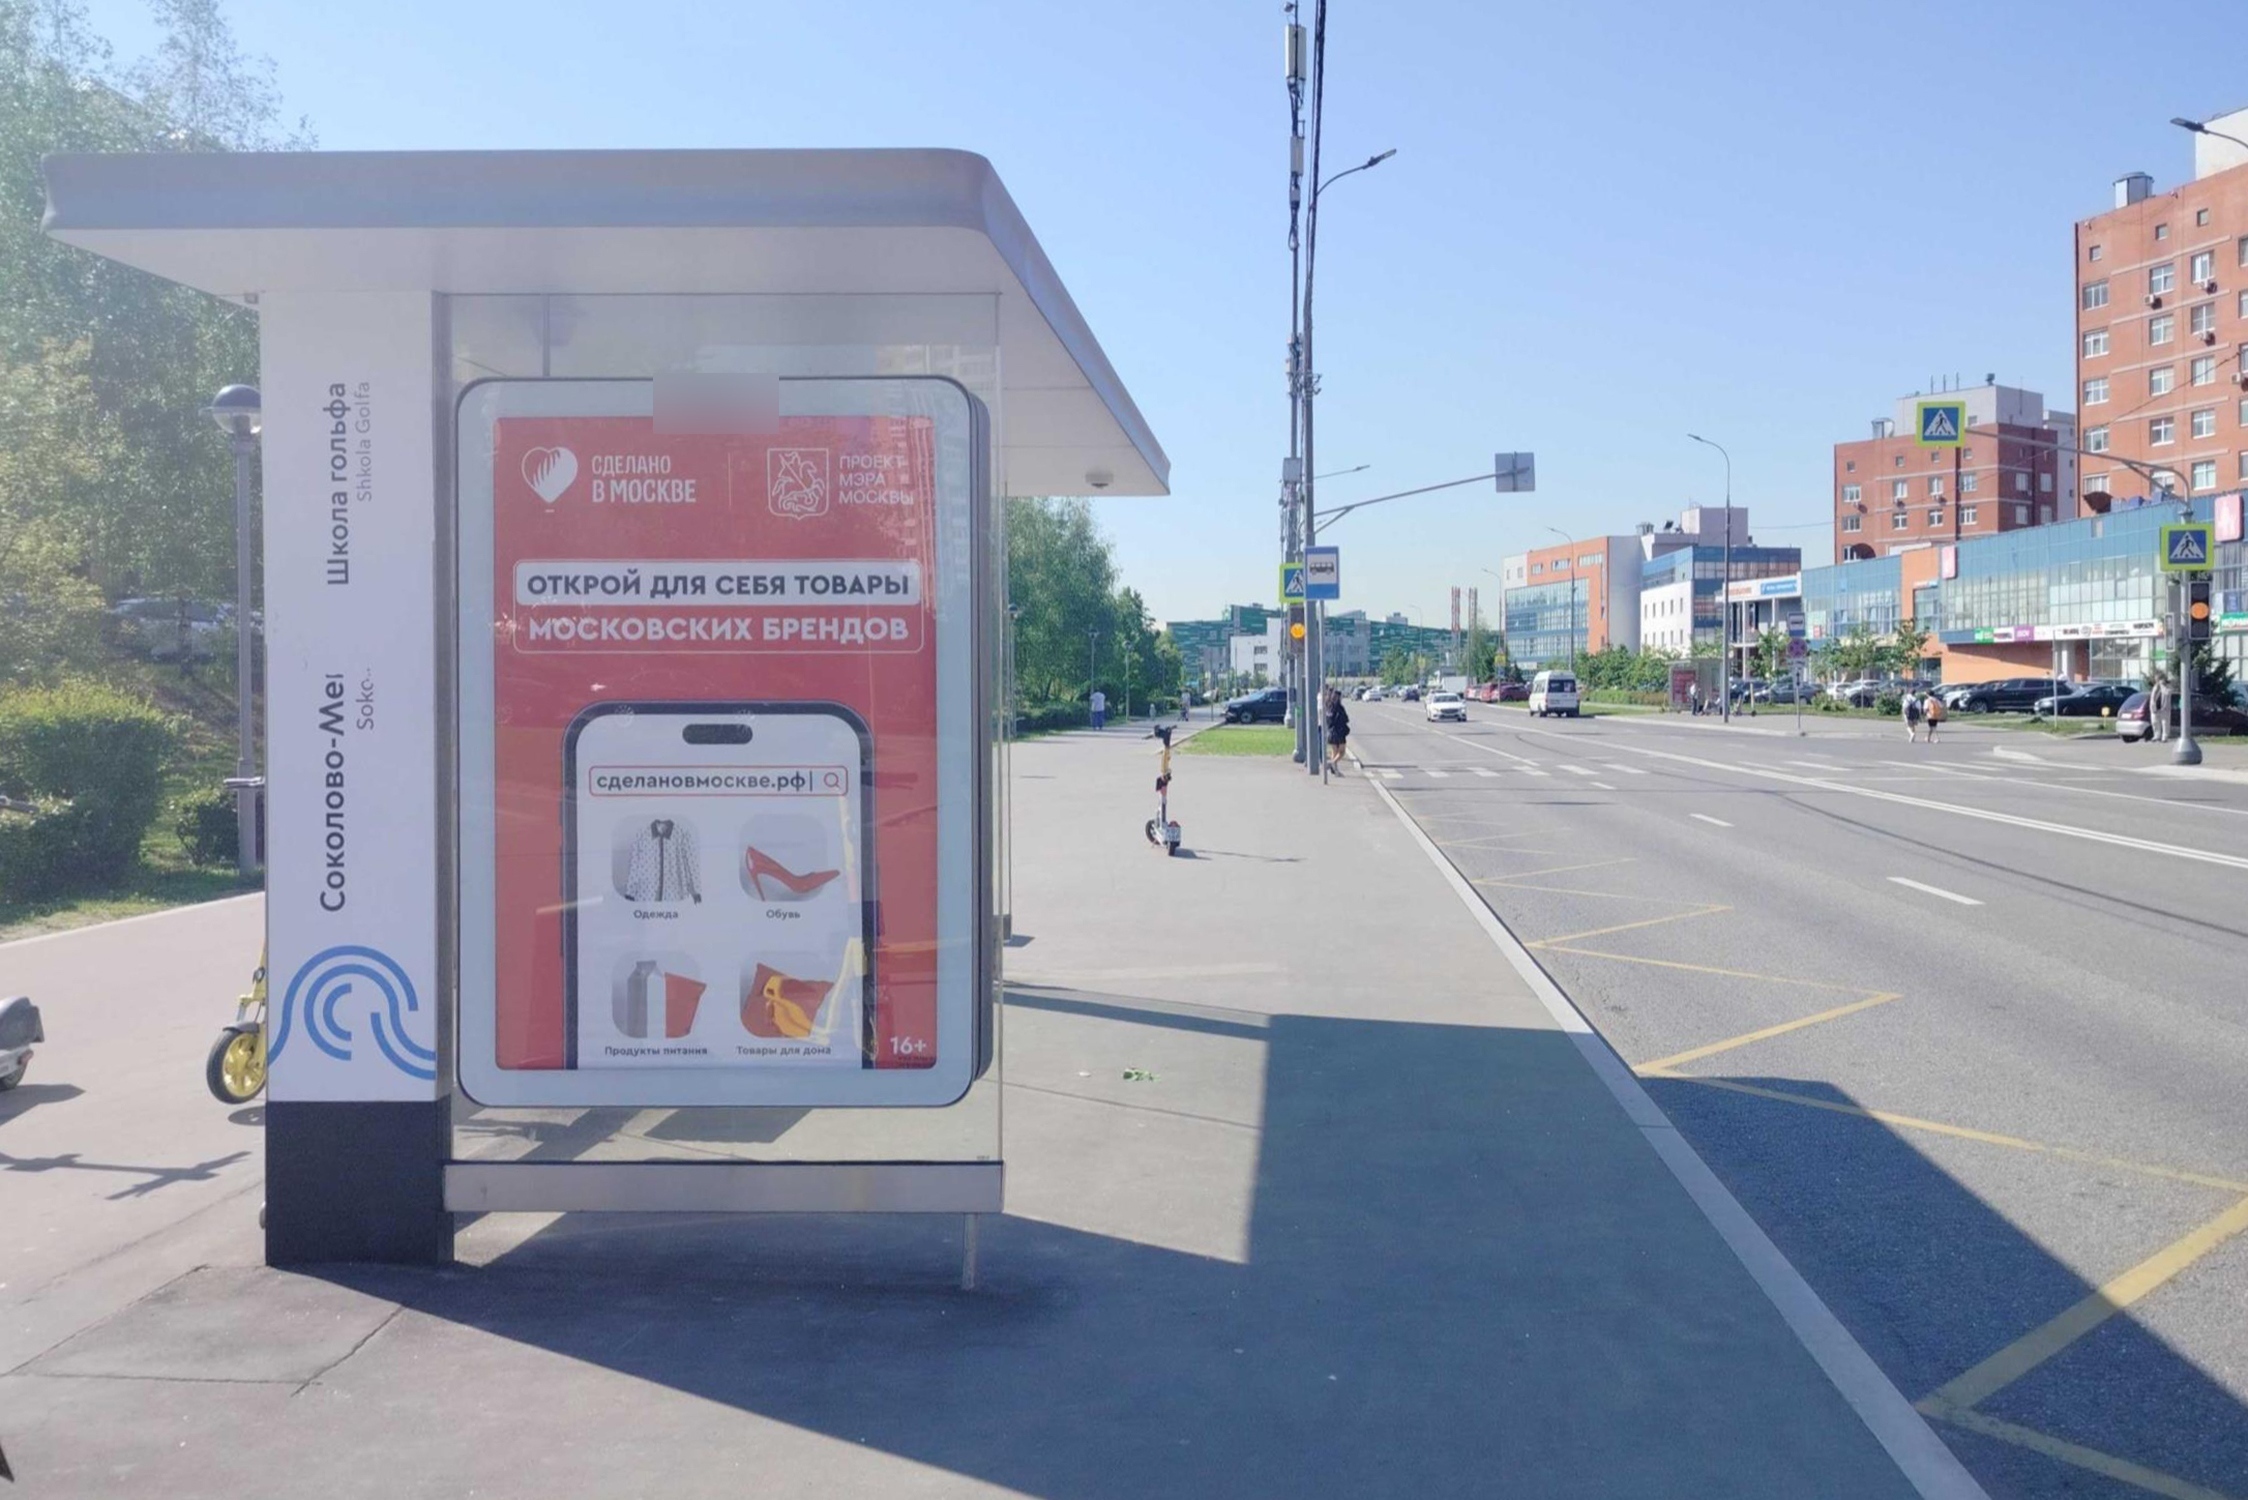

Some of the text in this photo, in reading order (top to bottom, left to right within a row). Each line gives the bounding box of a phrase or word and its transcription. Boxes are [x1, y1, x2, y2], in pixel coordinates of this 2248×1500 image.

[354, 381, 373, 502] Shkola Golfa
[591, 455, 672, 477] СДЕЛАНО
[839, 454, 905, 470] ПРОЕКТ
[322, 383, 352, 585] Школа гольфа
[839, 472, 886, 487] МЭРА
[592, 479, 697, 503] В МОСКВЕ
[838, 490, 915, 506] МОСКВЫ
[526, 568, 909, 598] ОТКРОЙ ДЛЯ СЕБЯ ТОВАРЫ
[529, 617, 909, 643] МОСКОВСКИХ БРЕНДОВ
[596, 770, 806, 793] сделановмоскве.рф
[633, 909, 679, 920] Одежда
[766, 909, 801, 921] Обувь
[604, 1046, 708, 1057] Продукты питания
[736, 1046, 777, 1056] Товары
[780, 1047, 801, 1056] для
[890, 1036, 927, 1055] 16+
